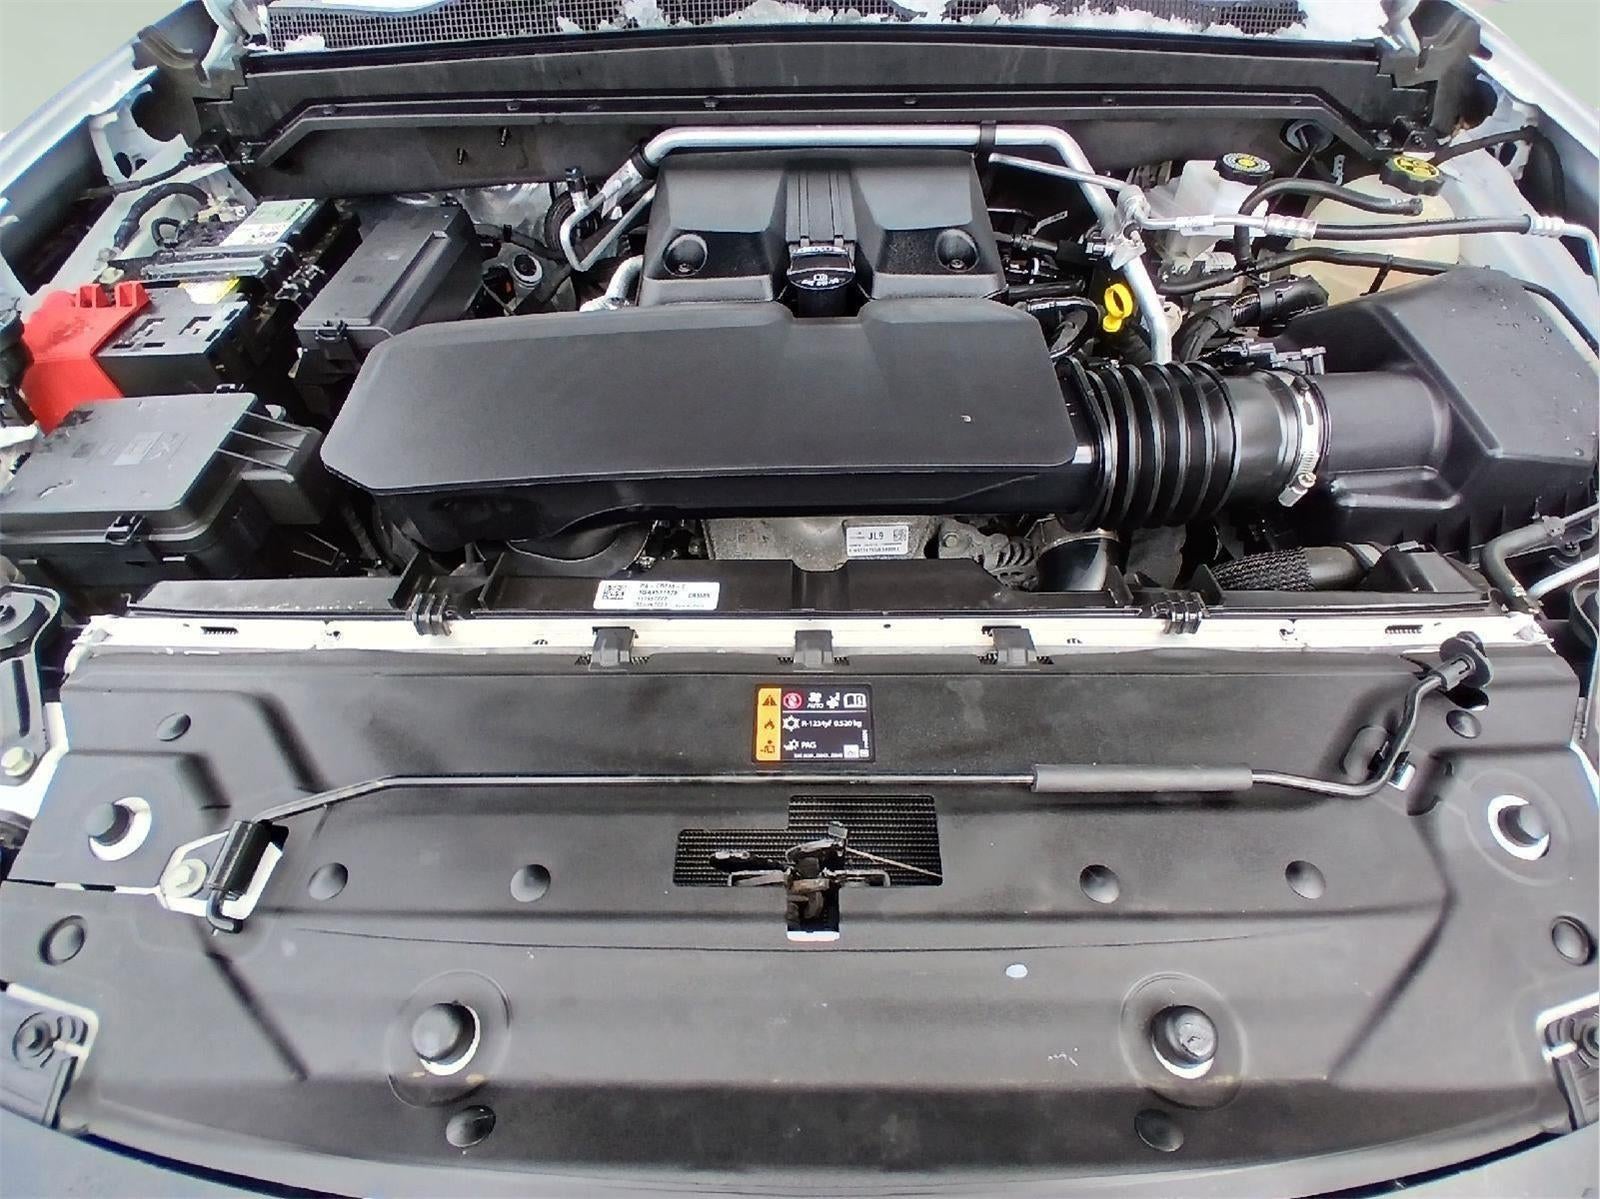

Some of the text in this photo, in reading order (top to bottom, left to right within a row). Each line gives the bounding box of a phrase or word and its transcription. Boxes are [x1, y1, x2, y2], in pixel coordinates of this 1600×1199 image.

[868, 531, 884, 540] JL9
[801, 719, 862, 729] R-1234yf 0.520 kg
[801, 741, 817, 749] PAG
